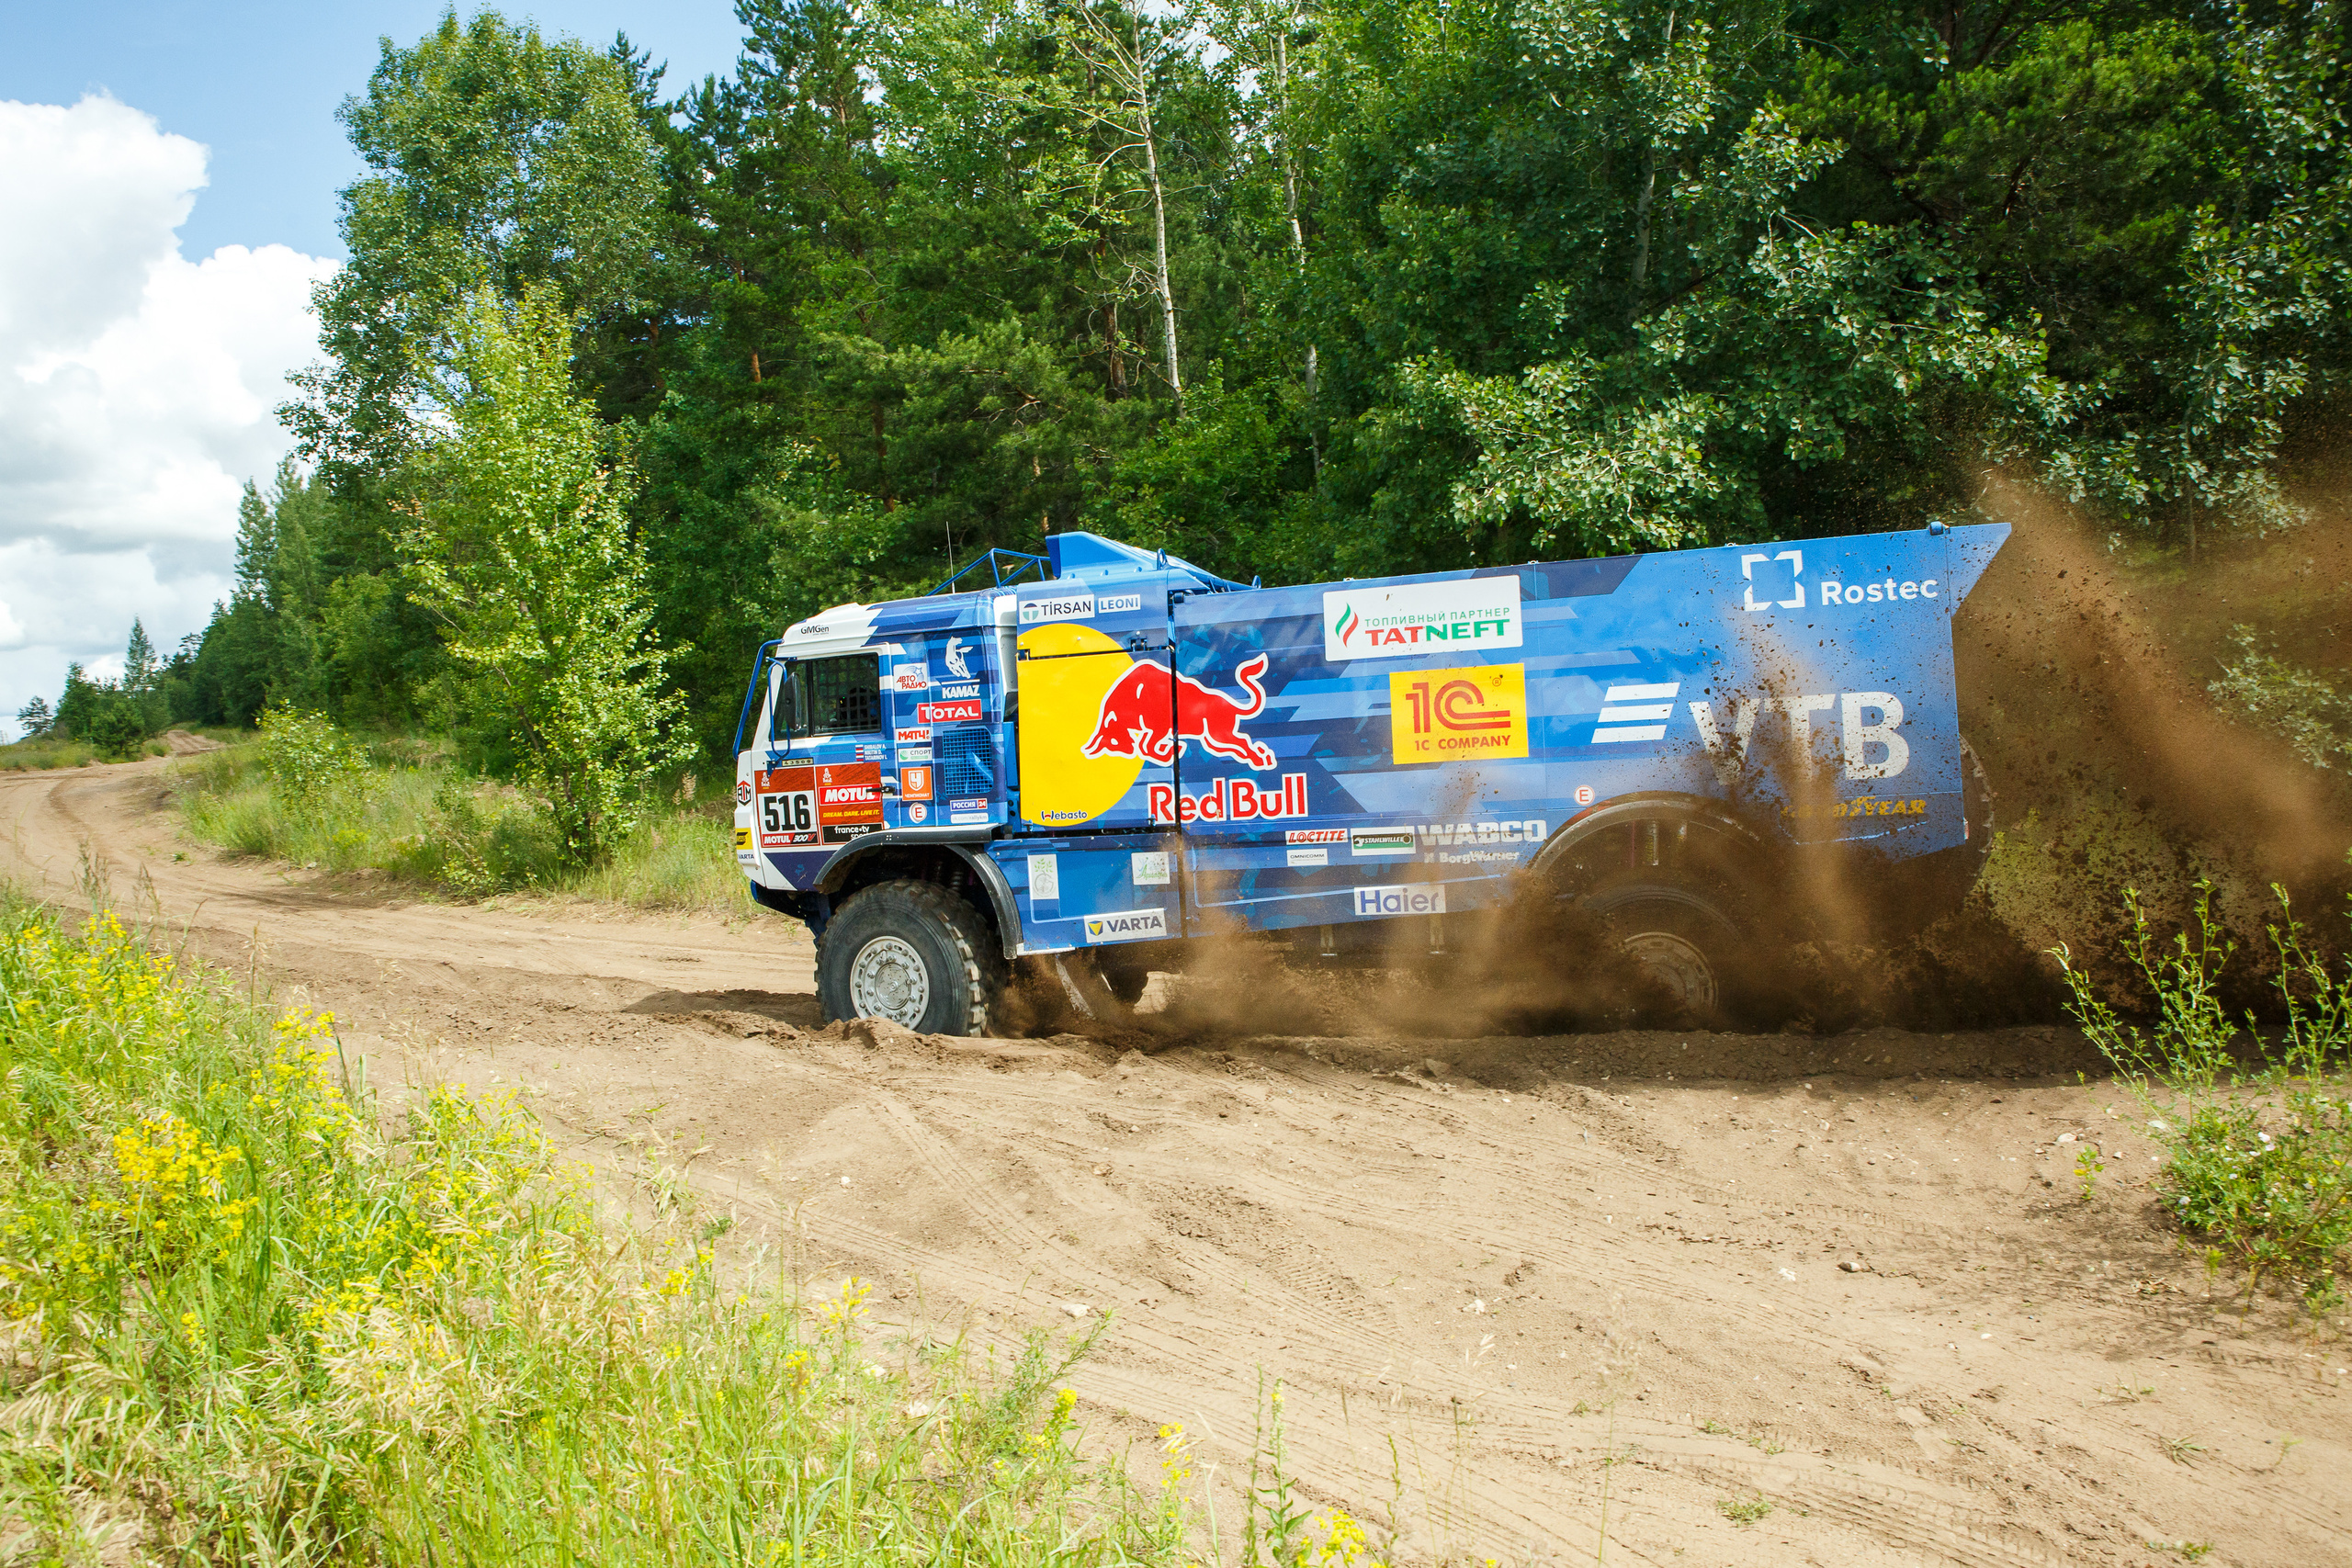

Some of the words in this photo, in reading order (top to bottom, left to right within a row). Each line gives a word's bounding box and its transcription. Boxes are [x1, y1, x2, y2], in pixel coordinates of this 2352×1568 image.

[1820, 578, 1939, 606] Rostec
[1100, 597, 1138, 611] LEONI
[1364, 611, 1446, 627] ТОПЛИВНЫЙ
[1450, 607, 1510, 621] ПАРТНЕР
[1364, 618, 1510, 647] TATNEFT
[897, 675, 916, 683] АВТО
[901, 681, 927, 690] РАДИО
[942, 684, 980, 699] KAMAZ
[921, 705, 979, 720] TOTAL
[1438, 735, 1511, 750] COMPANY
[1688, 691, 1910, 787] VTB
[824, 786, 876, 803] MOTUL
[1148, 778, 1225, 823] Red
[1230, 773, 1307, 820] Bull
[953, 801, 976, 809] РОССИЯ
[763, 794, 811, 832] 516
[1040, 809, 1088, 821] Webasto
[763, 834, 791, 844] MOTUL
[1288, 830, 1346, 843] LOCTITE
[1417, 819, 1548, 846] WABCO
[1439, 850, 1520, 864] BorgWarner
[1360, 887, 1439, 913] Haier
[1106, 916, 1163, 933] VARTA
